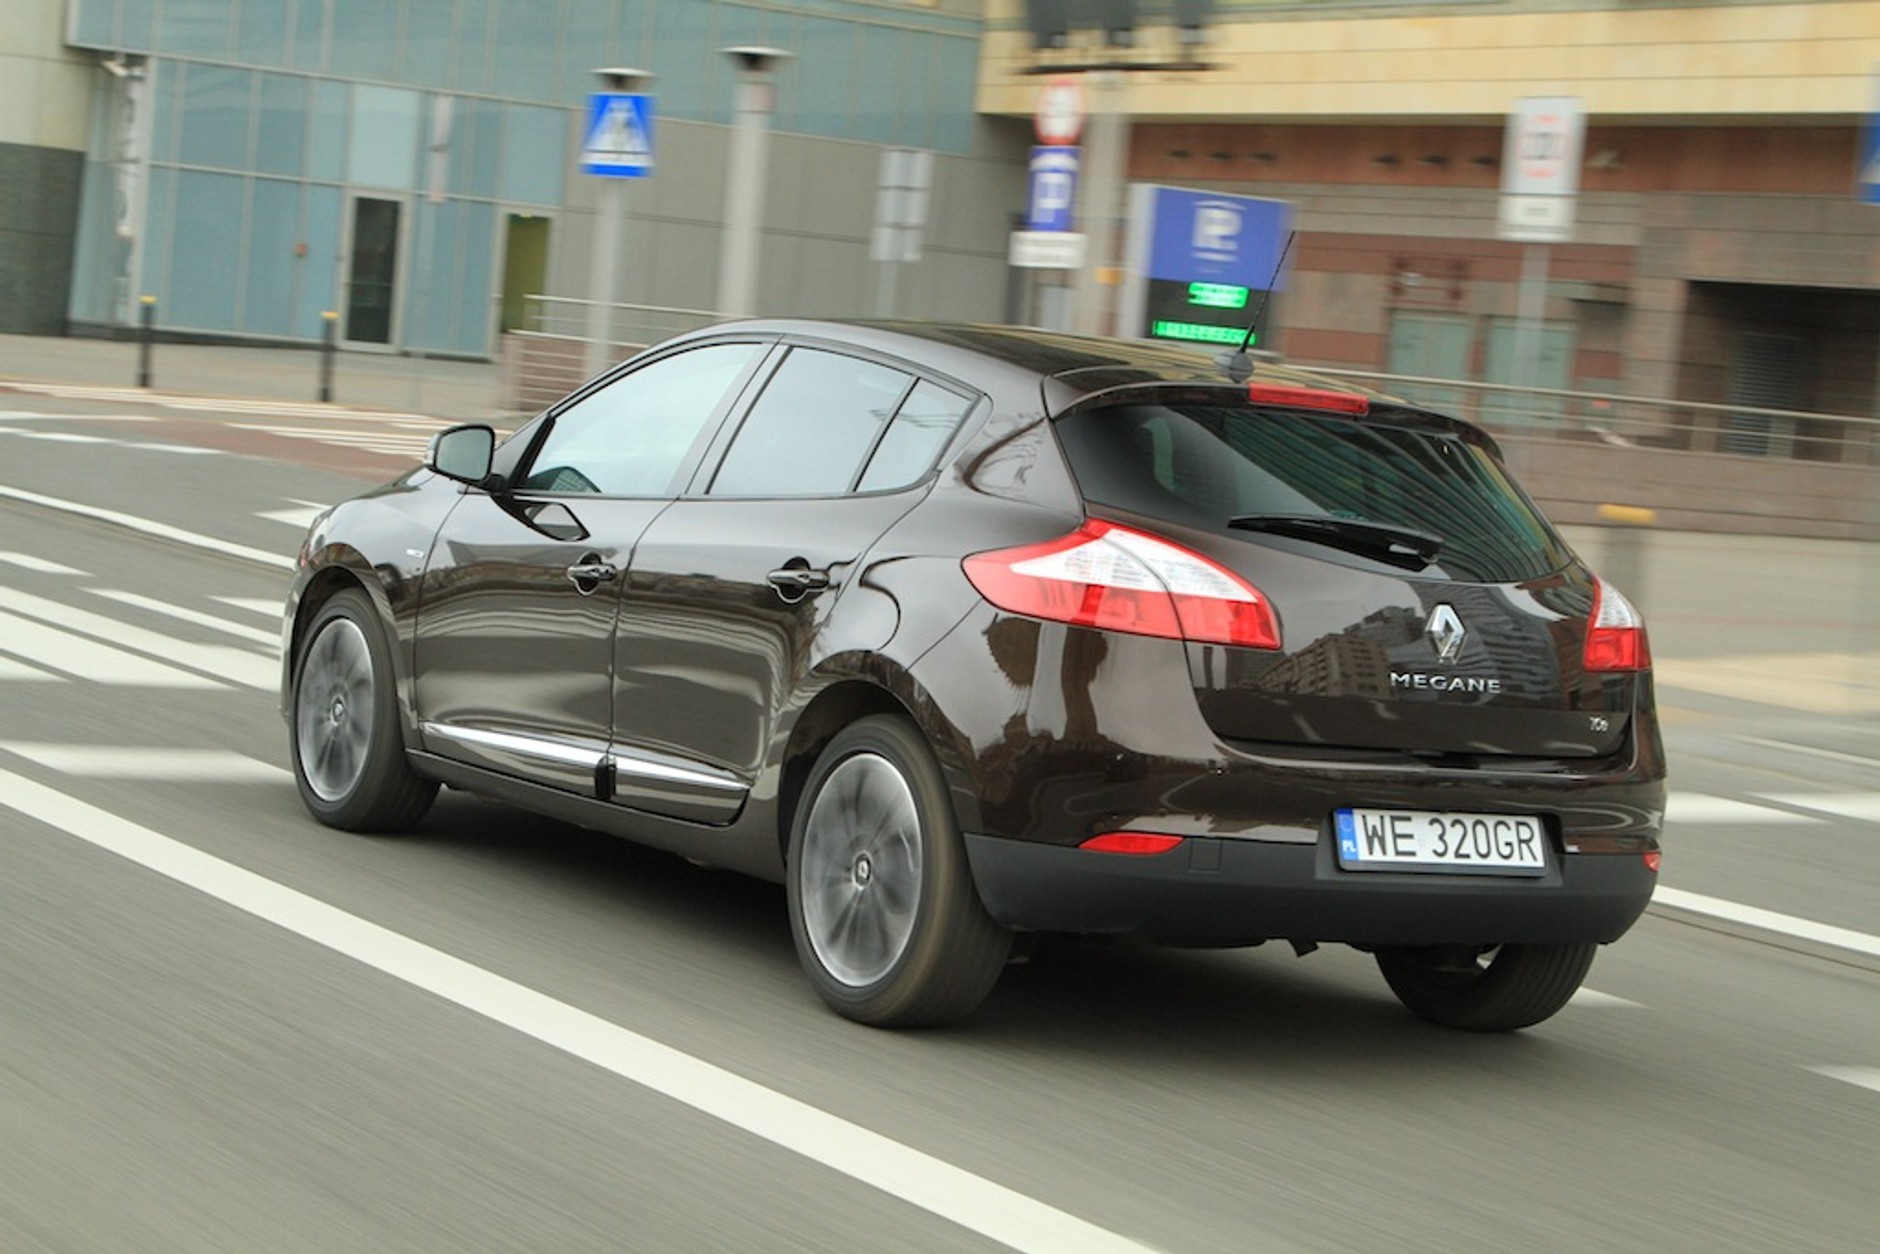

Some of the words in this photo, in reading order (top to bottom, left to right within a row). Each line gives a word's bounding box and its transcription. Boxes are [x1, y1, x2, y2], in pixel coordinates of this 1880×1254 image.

[1389, 671, 1501, 694] MEGANE
[1362, 814, 1417, 857] WE
[1428, 817, 1538, 862] 320GR
